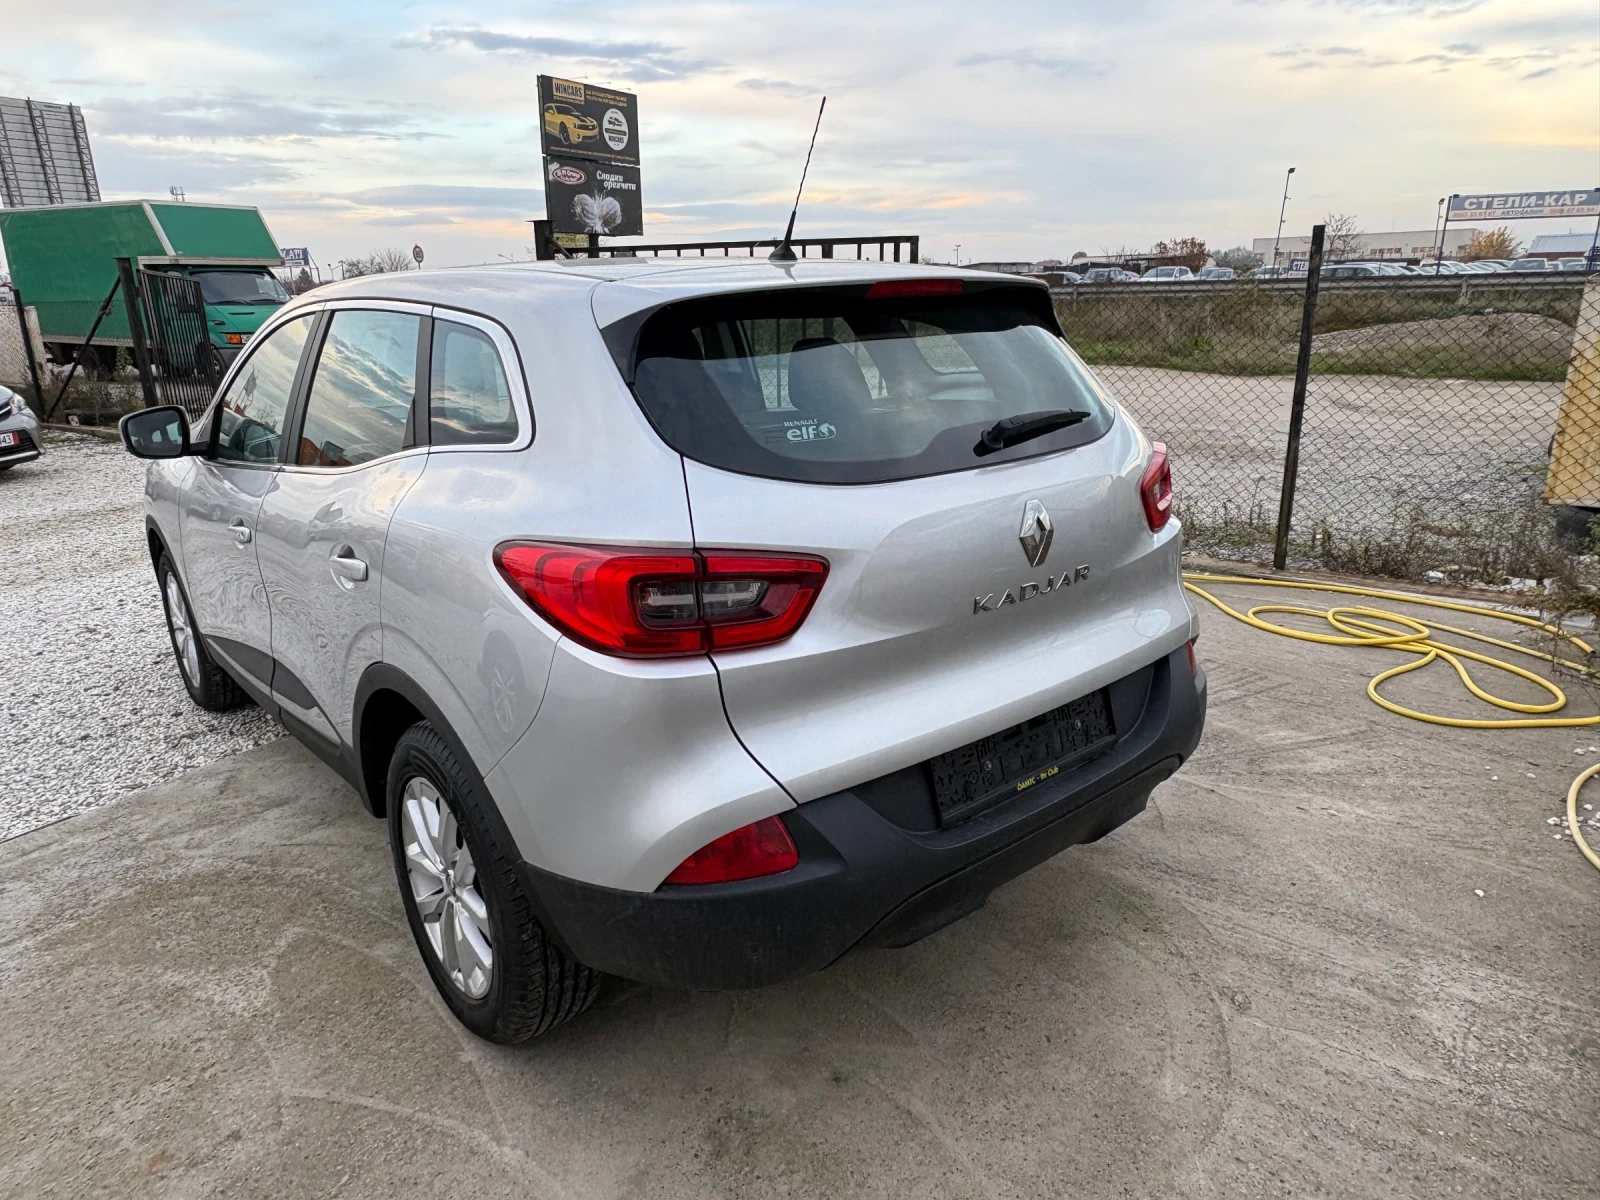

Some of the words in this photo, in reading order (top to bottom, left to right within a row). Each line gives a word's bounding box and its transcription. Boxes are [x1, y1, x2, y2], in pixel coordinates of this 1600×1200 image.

[554, 82, 583, 98] WINCARS
[596, 170, 624, 182] Сладки
[603, 180, 637, 190] орехчета
[1463, 193, 1588, 210] СТЕЛИ-КАР
[1500, 208, 1544, 216] АВТОСАЛОН
[783, 418, 818, 427] RENAULT
[786, 425, 818, 441] elf
[973, 564, 1090, 615] KADJAR
